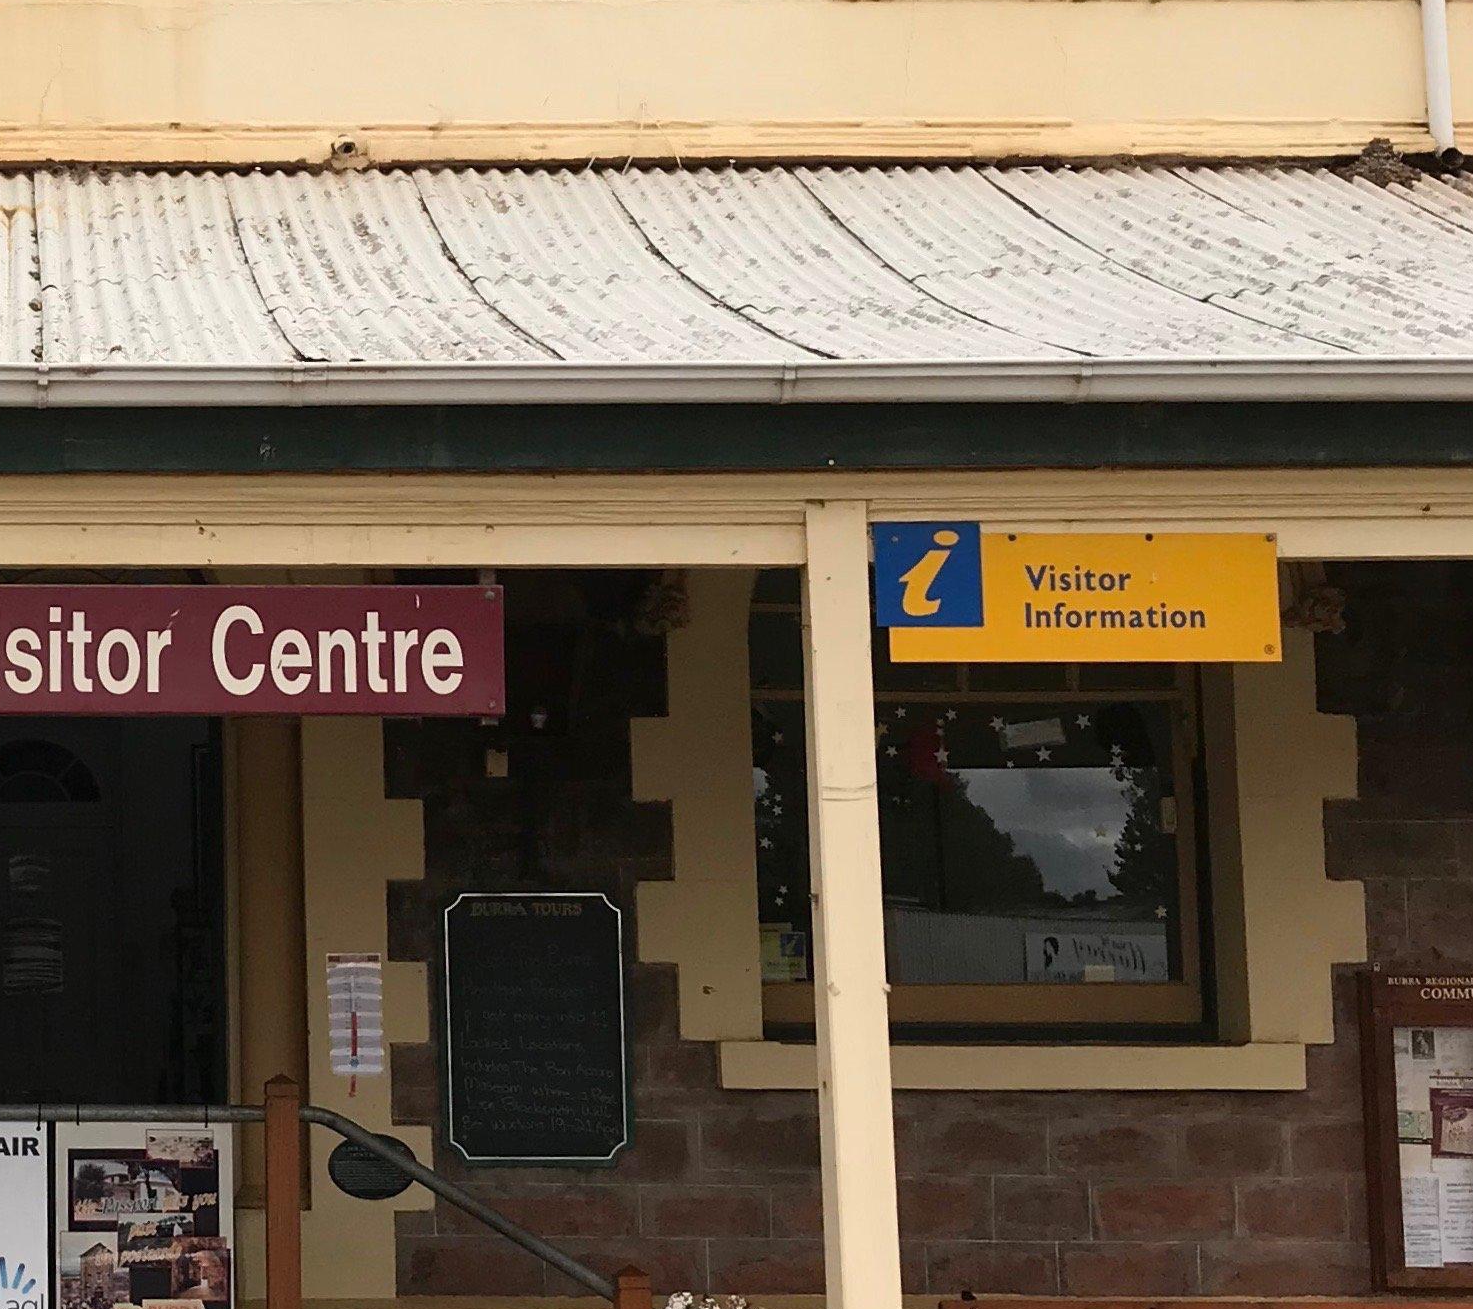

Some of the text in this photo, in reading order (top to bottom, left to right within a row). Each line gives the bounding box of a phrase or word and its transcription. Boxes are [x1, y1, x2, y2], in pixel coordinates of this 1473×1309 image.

[1024, 564, 1132, 592] Visitor
[1025, 601, 1207, 629] Information
[212, 603, 464, 696] Centre
[532, 902, 582, 917] TOURS
[1387, 977, 1421, 985] BURRA
